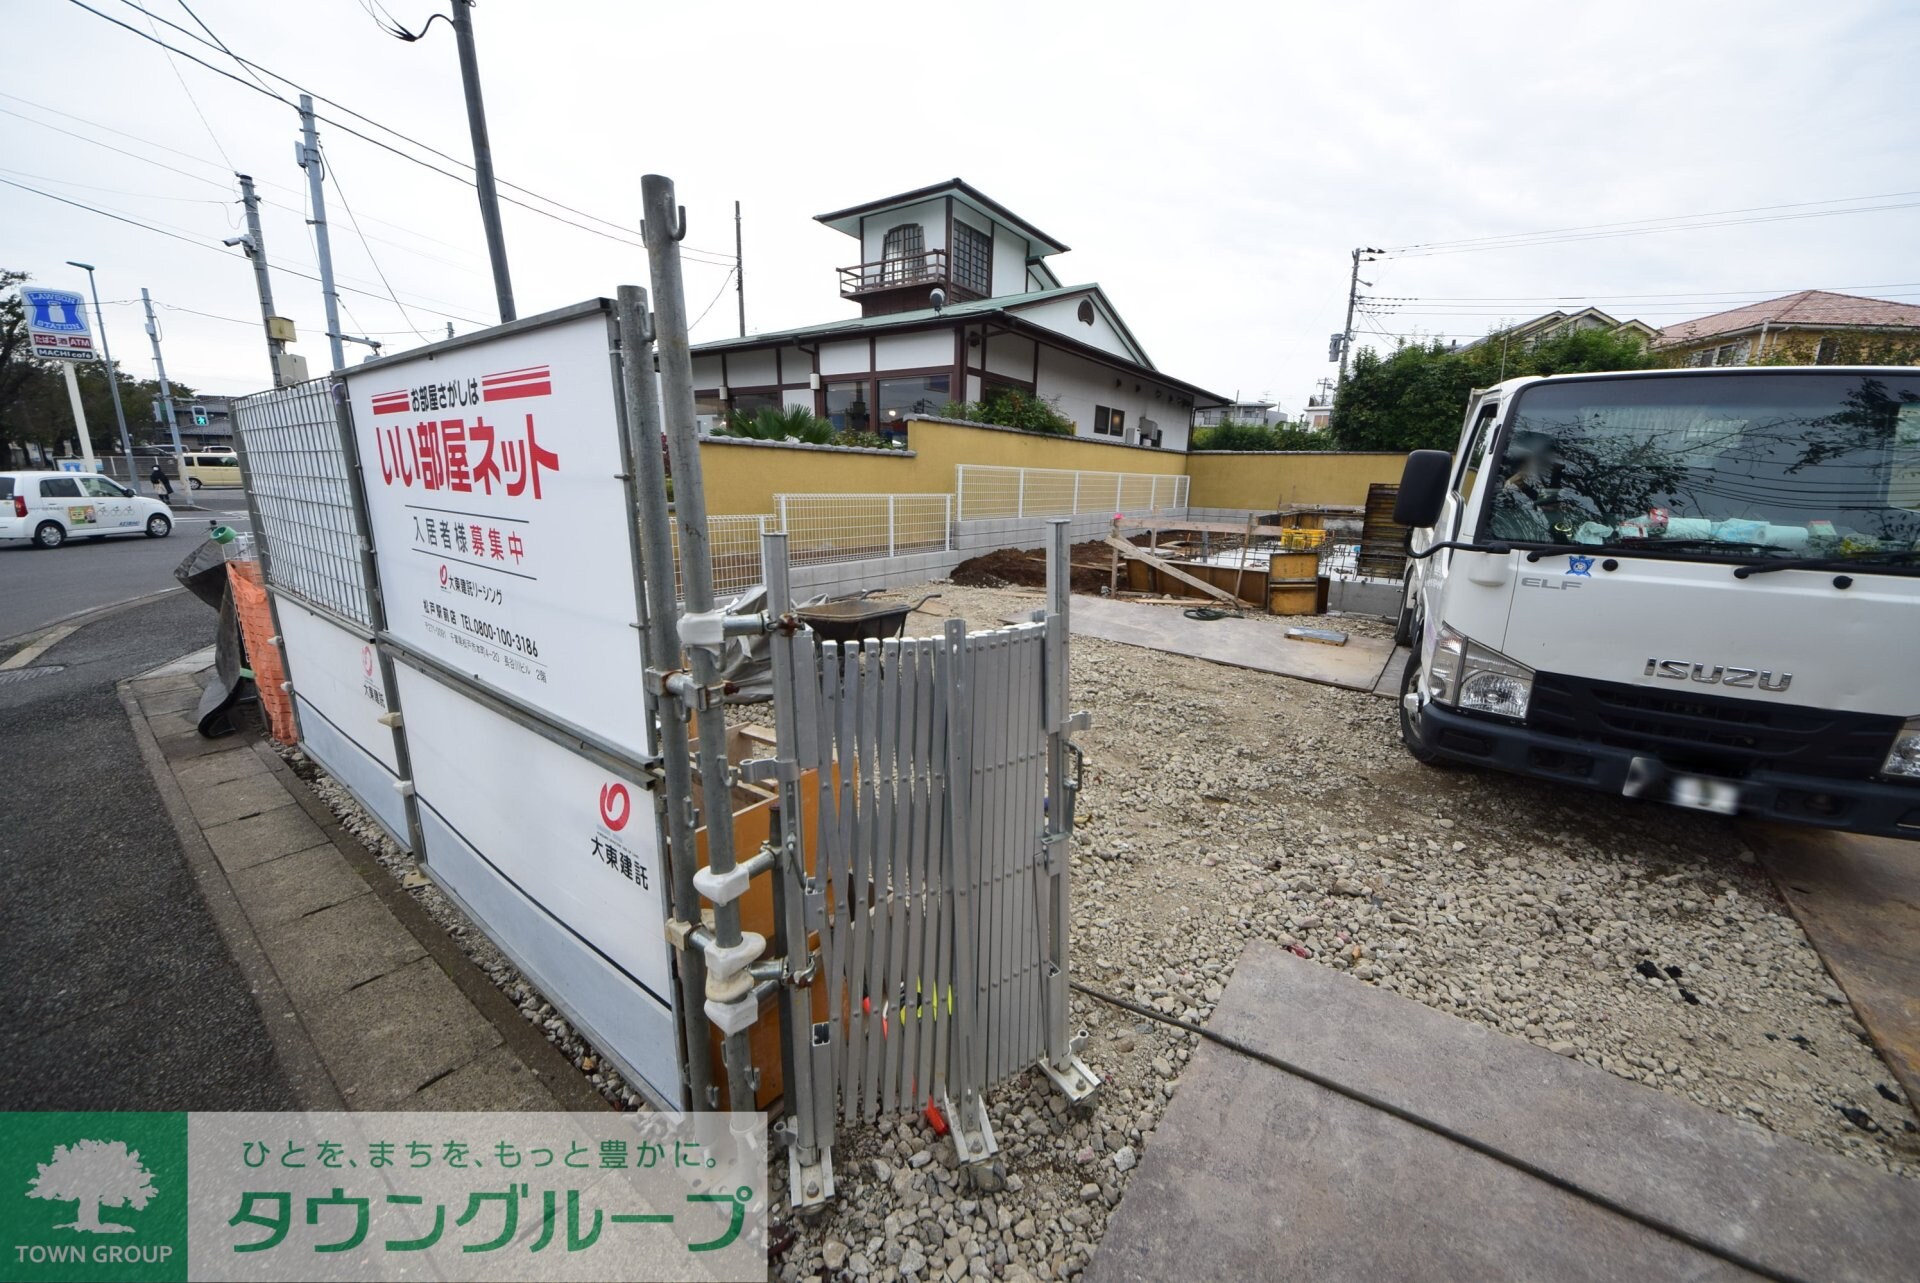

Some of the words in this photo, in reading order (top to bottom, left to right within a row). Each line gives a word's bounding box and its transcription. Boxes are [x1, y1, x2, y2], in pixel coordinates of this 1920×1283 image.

[30, 293, 76, 304] LAWSON
[37, 320, 81, 329] STATION
[39, 349, 70, 357] MACHI
[70, 338, 90, 347] ATM
[411, 378, 480, 412] お部屋さがしは
[376, 413, 560, 500] いい部屋ネット
[413, 515, 525, 566] 入居者様募集中
[448, 575, 503, 606] 大東建託リーシング
[1521, 577, 1582, 590] ELF
[423, 600, 457, 625] 松戸駅前店
[1644, 657, 1793, 692] ISUZU
[591, 836, 649, 891] 大東建託
